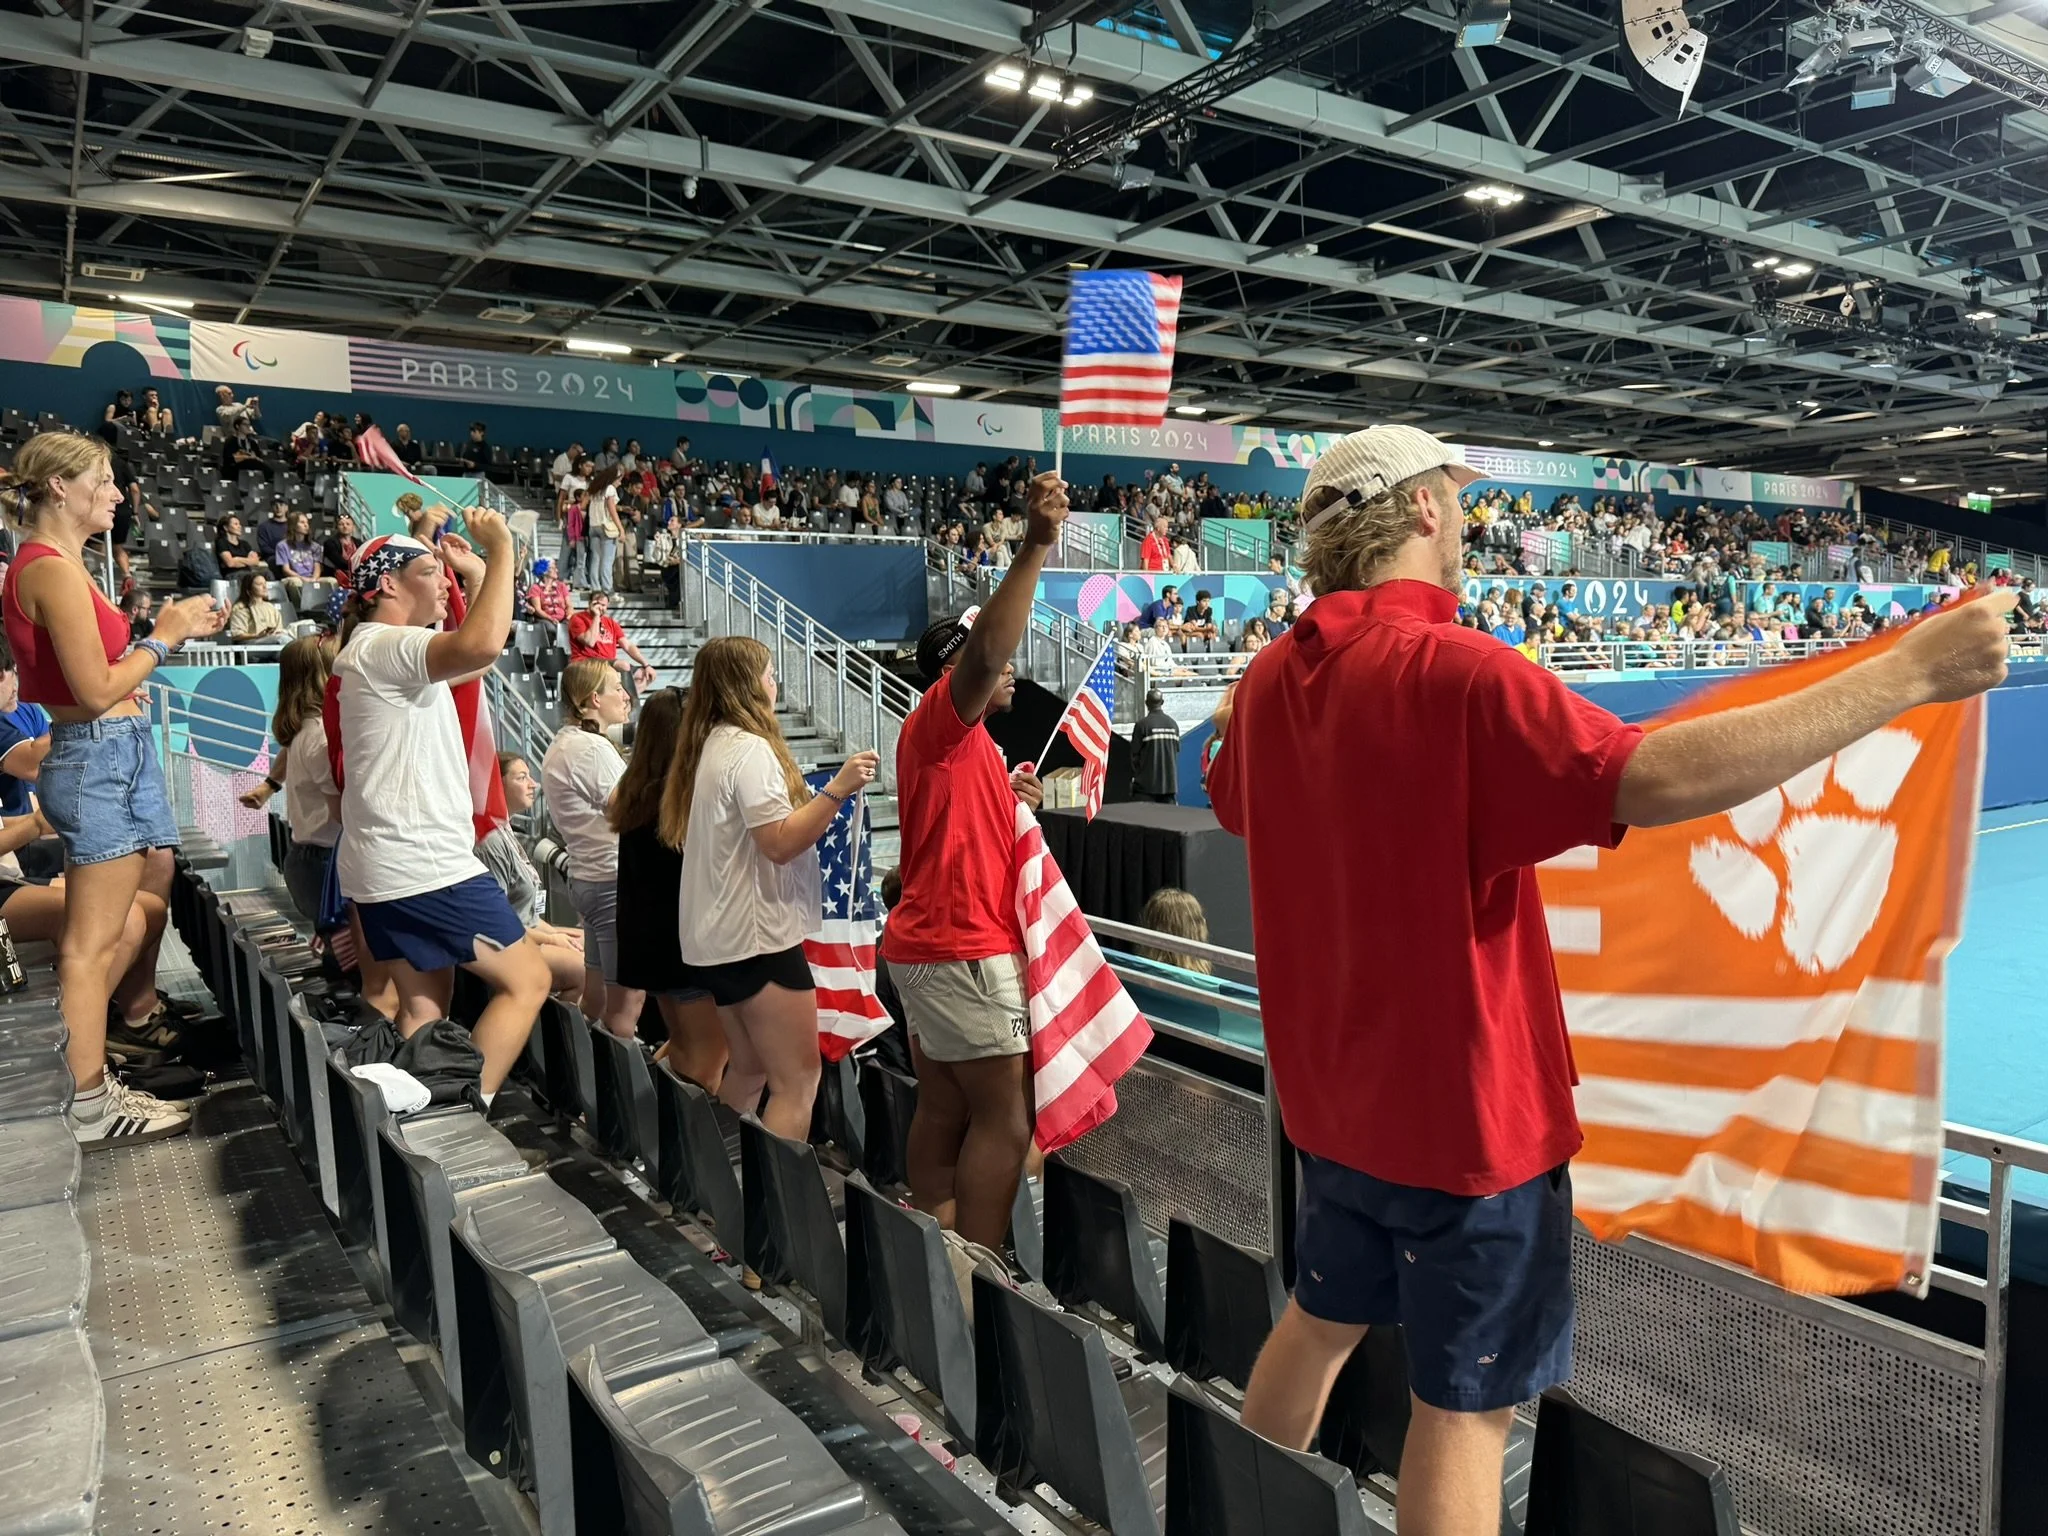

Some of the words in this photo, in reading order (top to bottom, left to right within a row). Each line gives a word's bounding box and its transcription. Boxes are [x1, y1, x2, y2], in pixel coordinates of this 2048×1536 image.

[536, 370, 634, 402] 2024
[1150, 428, 1208, 451] 2024
[1536, 461, 1577, 478] 2024
[938, 632, 964, 659] SMITH
